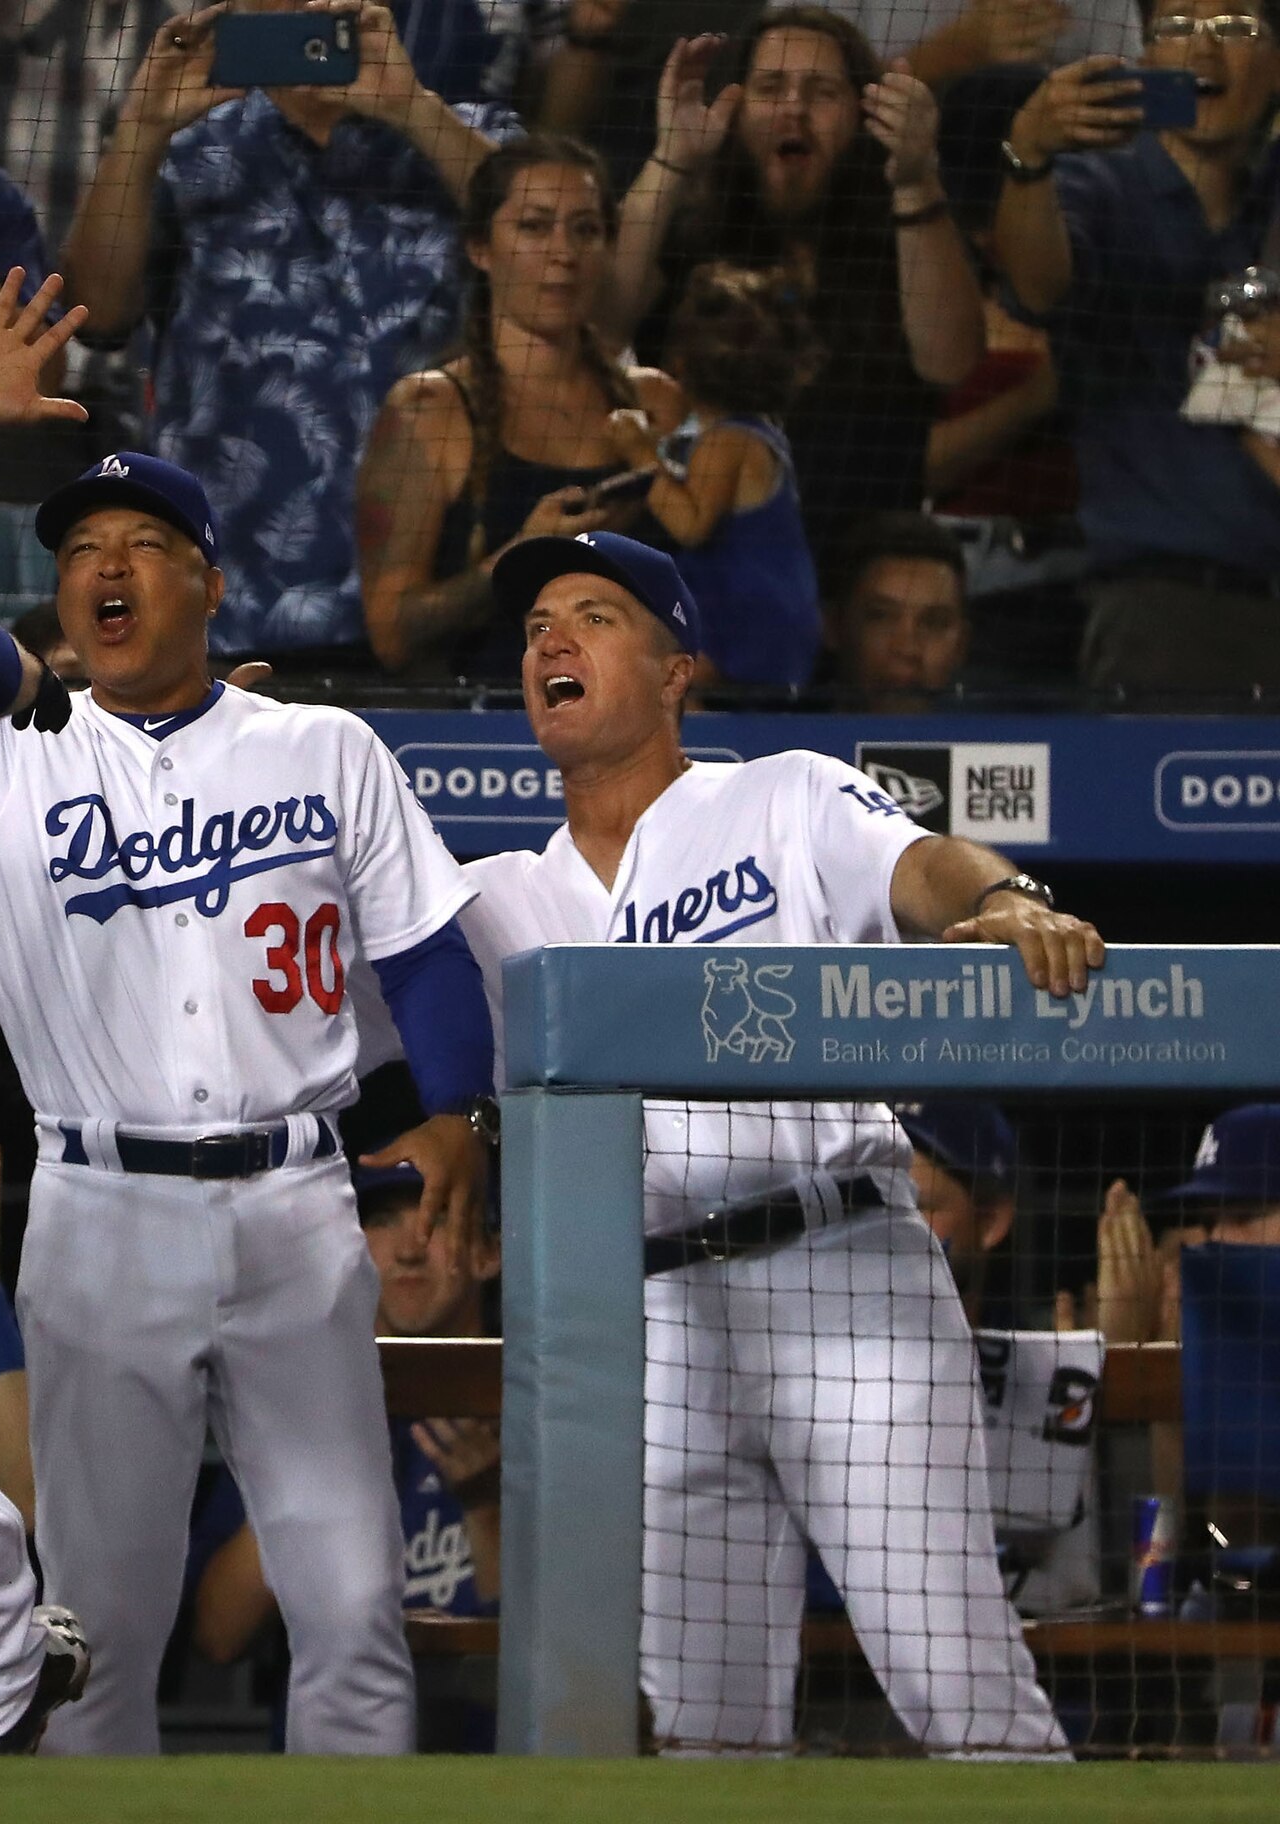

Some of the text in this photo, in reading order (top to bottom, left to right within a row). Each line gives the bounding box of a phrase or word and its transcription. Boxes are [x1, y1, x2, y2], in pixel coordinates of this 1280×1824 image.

[967, 765, 1034, 790] NEW
[1181, 775, 1280, 807] DOD
[967, 793, 1034, 820] ERA
[45, 794, 338, 918] Dodgers
[244, 902, 346, 1015] 30
[820, 964, 1012, 1019] Merrill
[822, 1036, 1227, 1068] Bank of America Corporation
